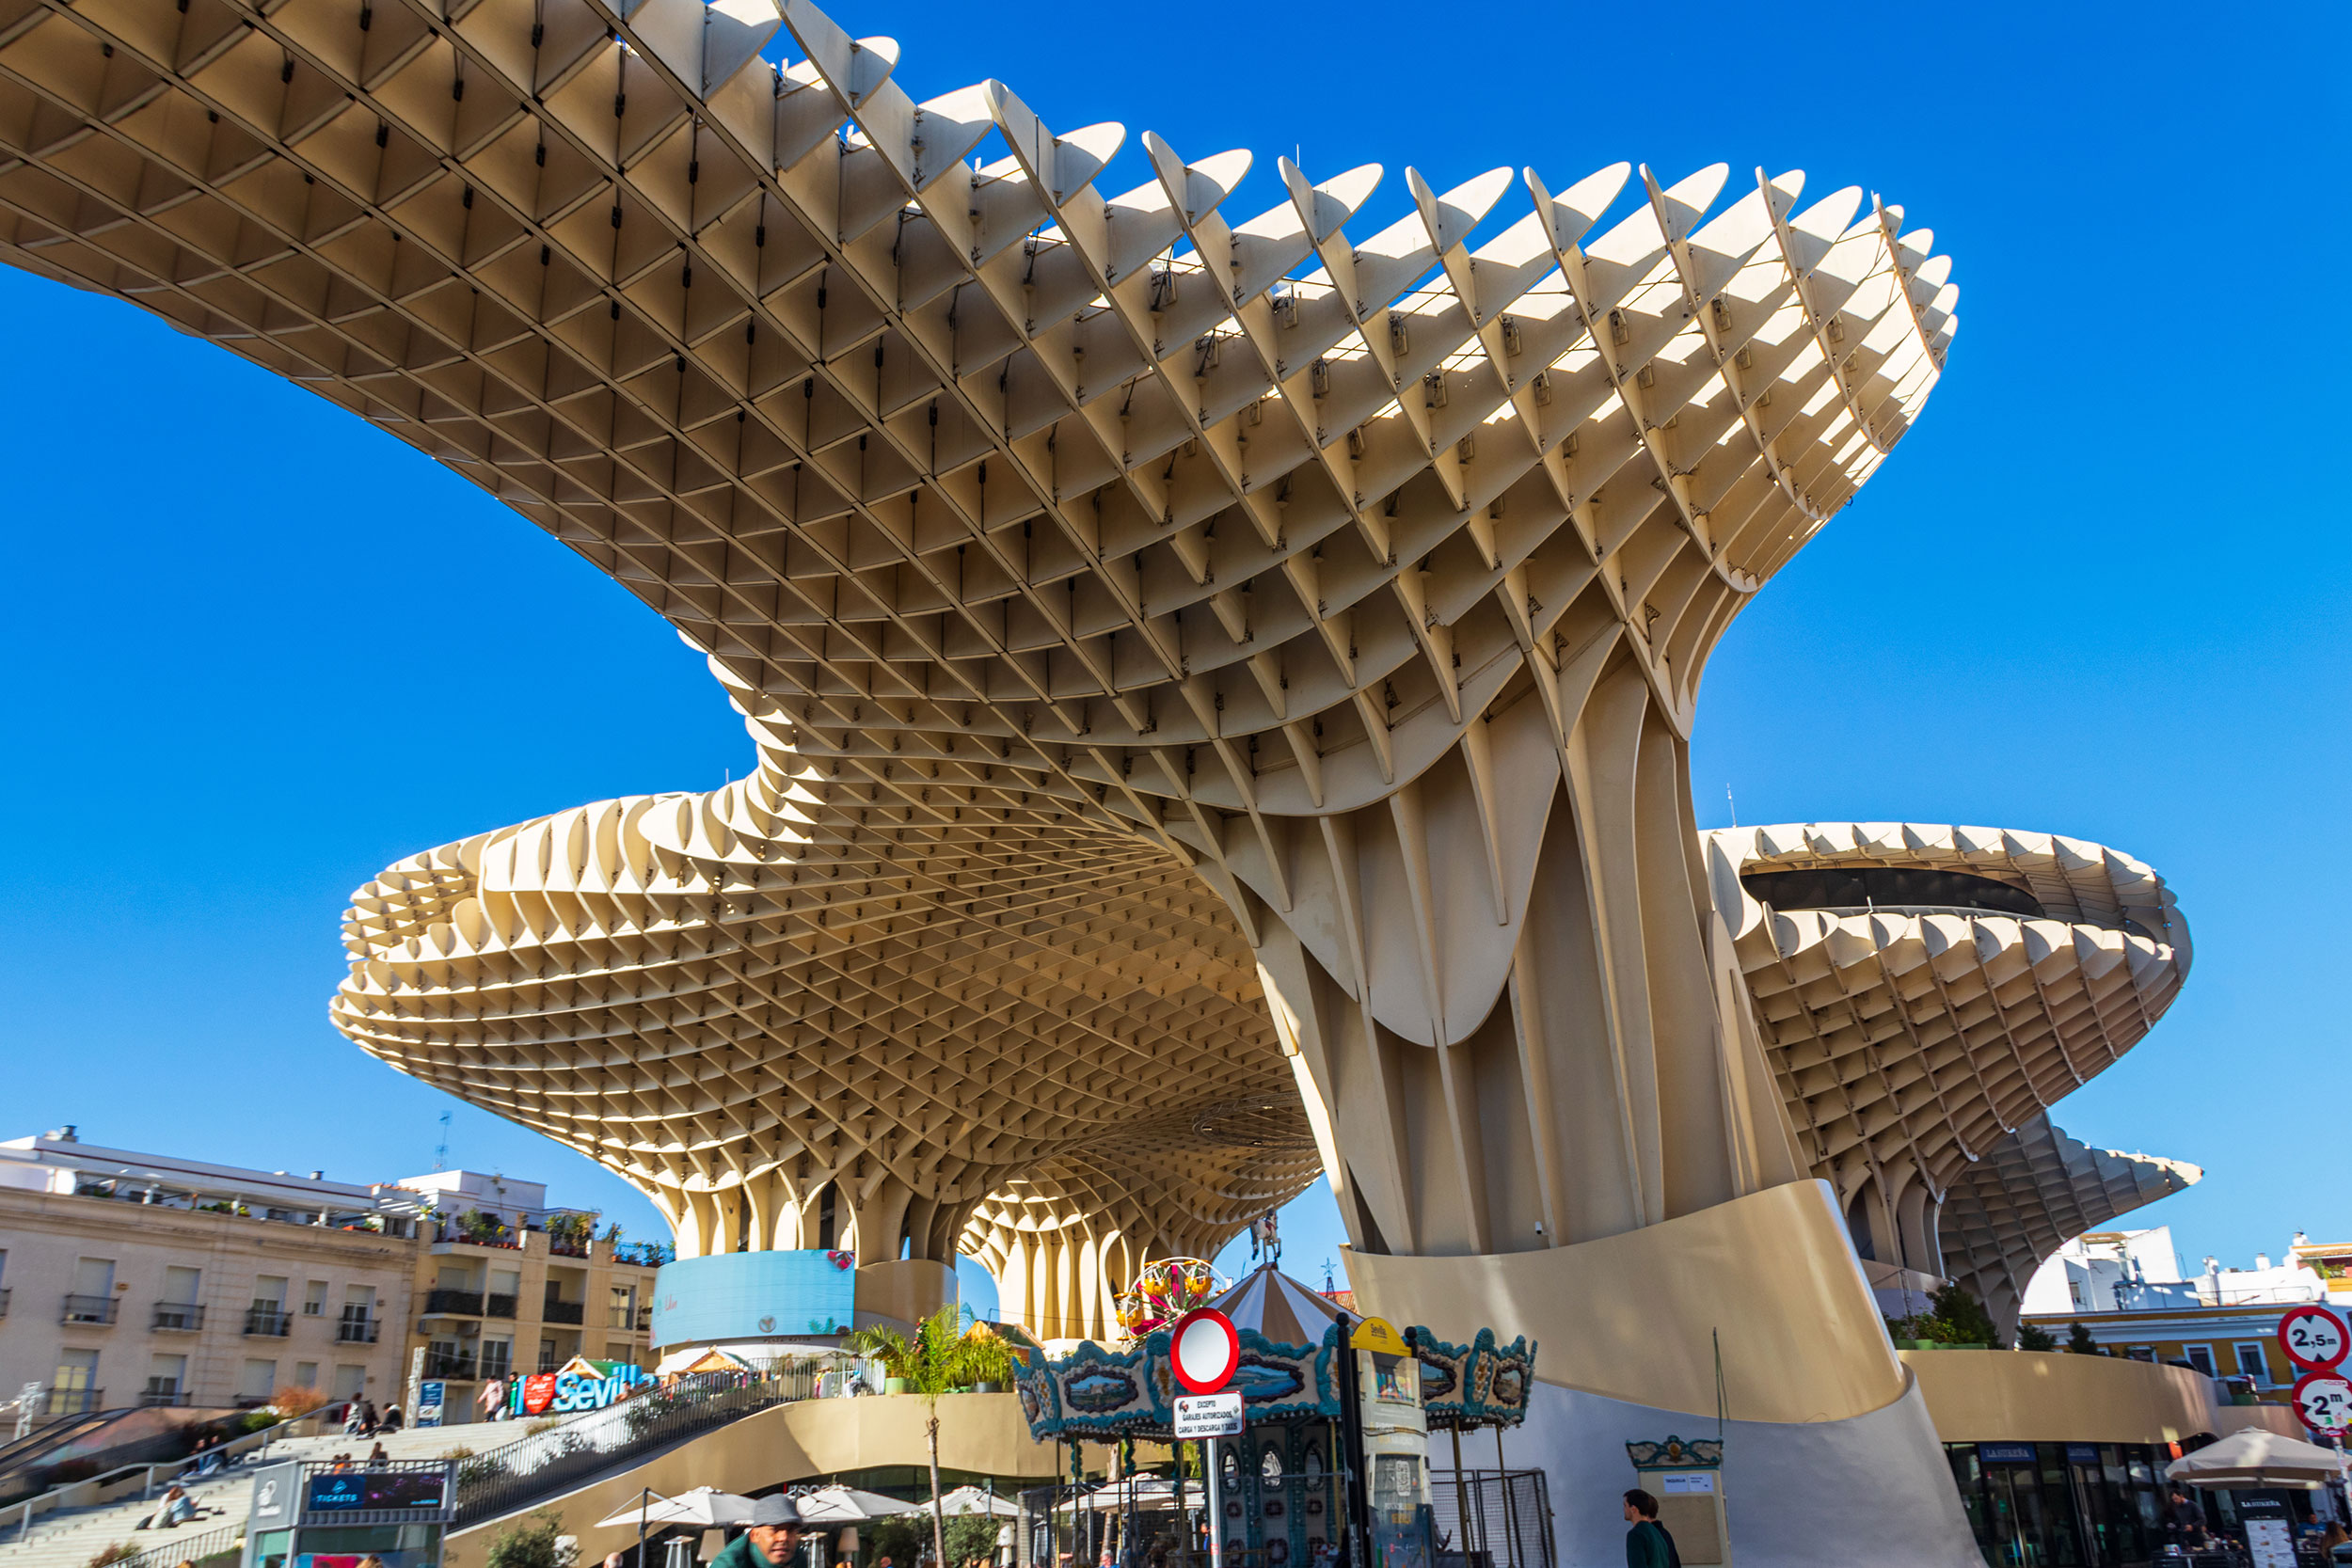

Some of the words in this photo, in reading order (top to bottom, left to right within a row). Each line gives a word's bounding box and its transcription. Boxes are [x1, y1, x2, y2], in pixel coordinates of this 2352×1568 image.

[1197, 1400, 1216, 1409] EXCEPTO
[1183, 1413, 1201, 1421] GARAJES
[1198, 1423, 1220, 1433] DESCARGA
[316, 1494, 358, 1503] TICKETS
